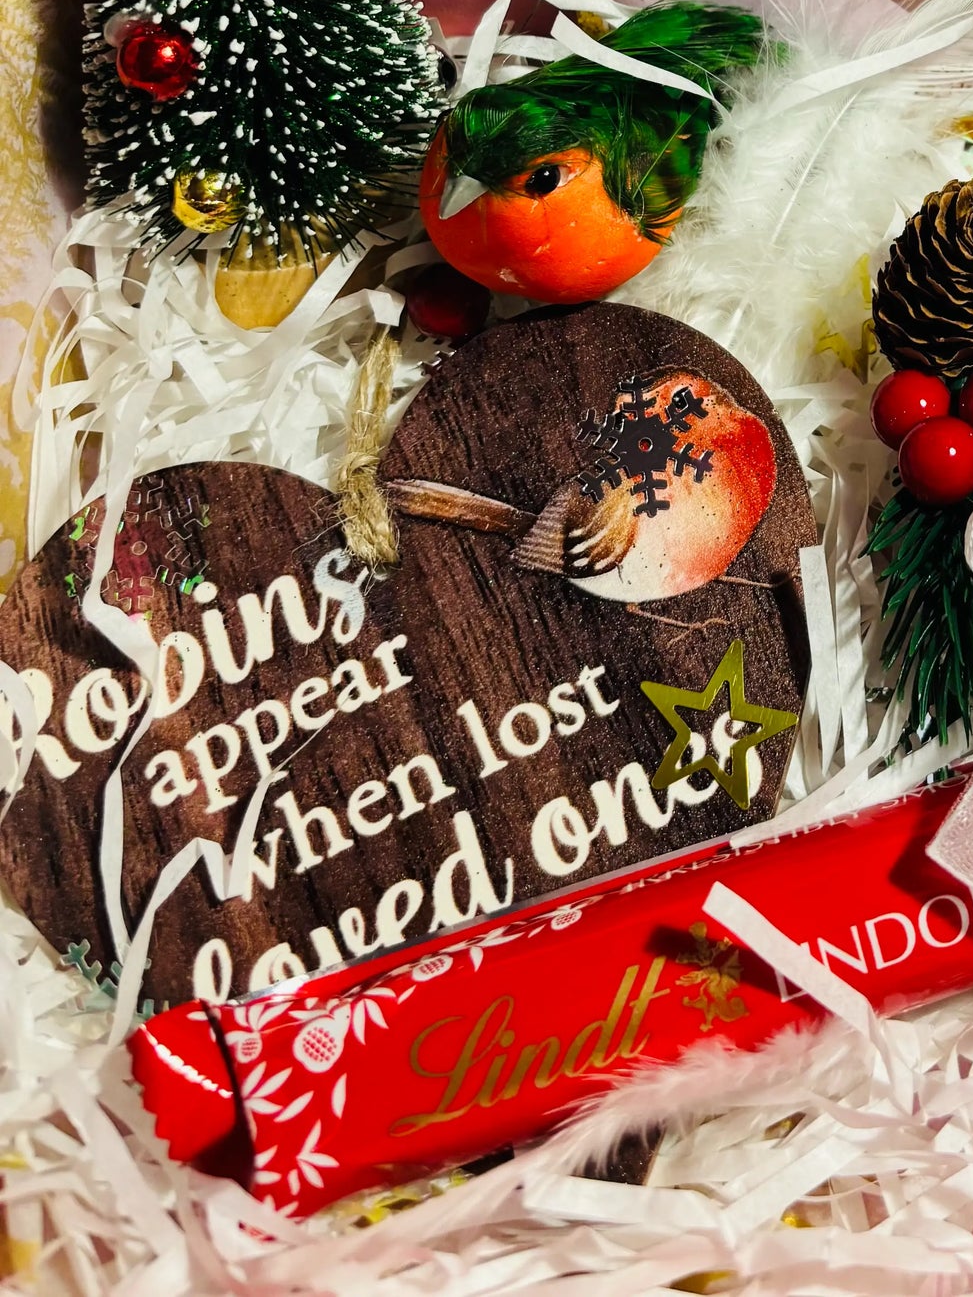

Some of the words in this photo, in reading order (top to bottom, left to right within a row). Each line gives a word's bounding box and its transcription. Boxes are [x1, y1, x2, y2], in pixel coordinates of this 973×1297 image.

[145, 634, 412, 813] appear
[243, 752, 457, 902] when
[462, 663, 620, 778] lost
[389, 956, 674, 1137] Lindt
